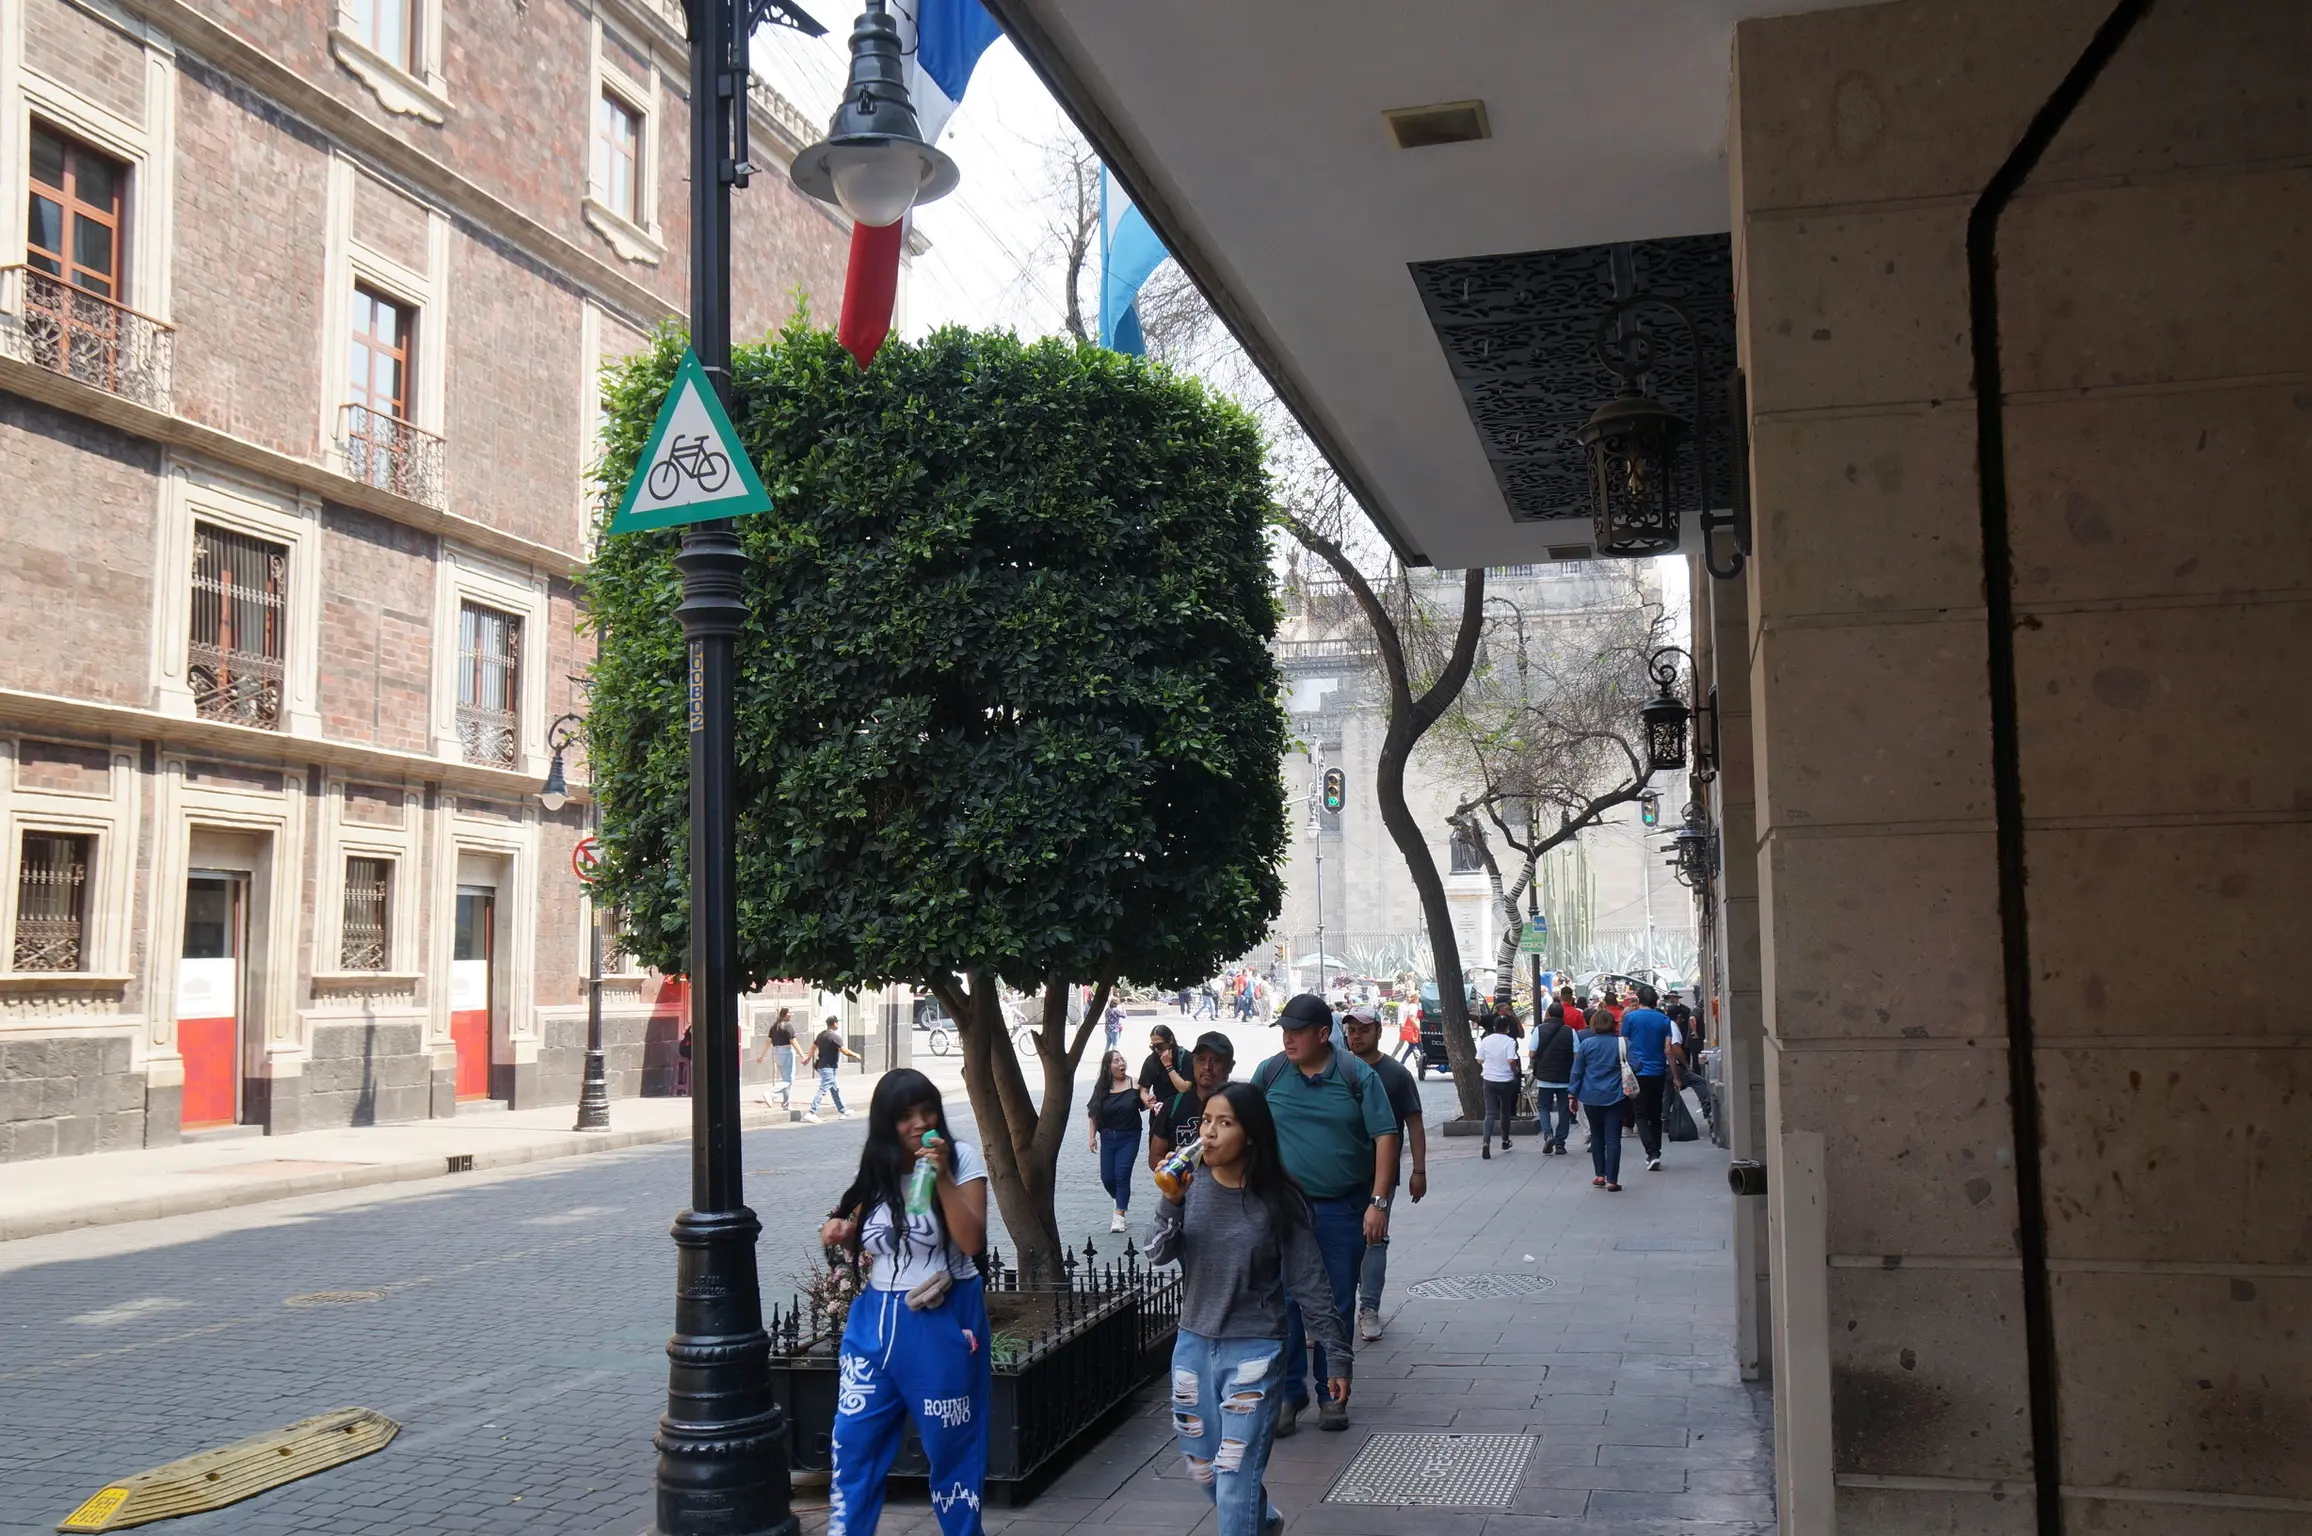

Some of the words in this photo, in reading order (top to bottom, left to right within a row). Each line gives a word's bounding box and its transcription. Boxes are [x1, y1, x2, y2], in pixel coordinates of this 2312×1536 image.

[923, 1395, 970, 1417] ROUND
[941, 1409, 971, 1429] TWO
[1420, 1459, 1454, 1478] CFE
